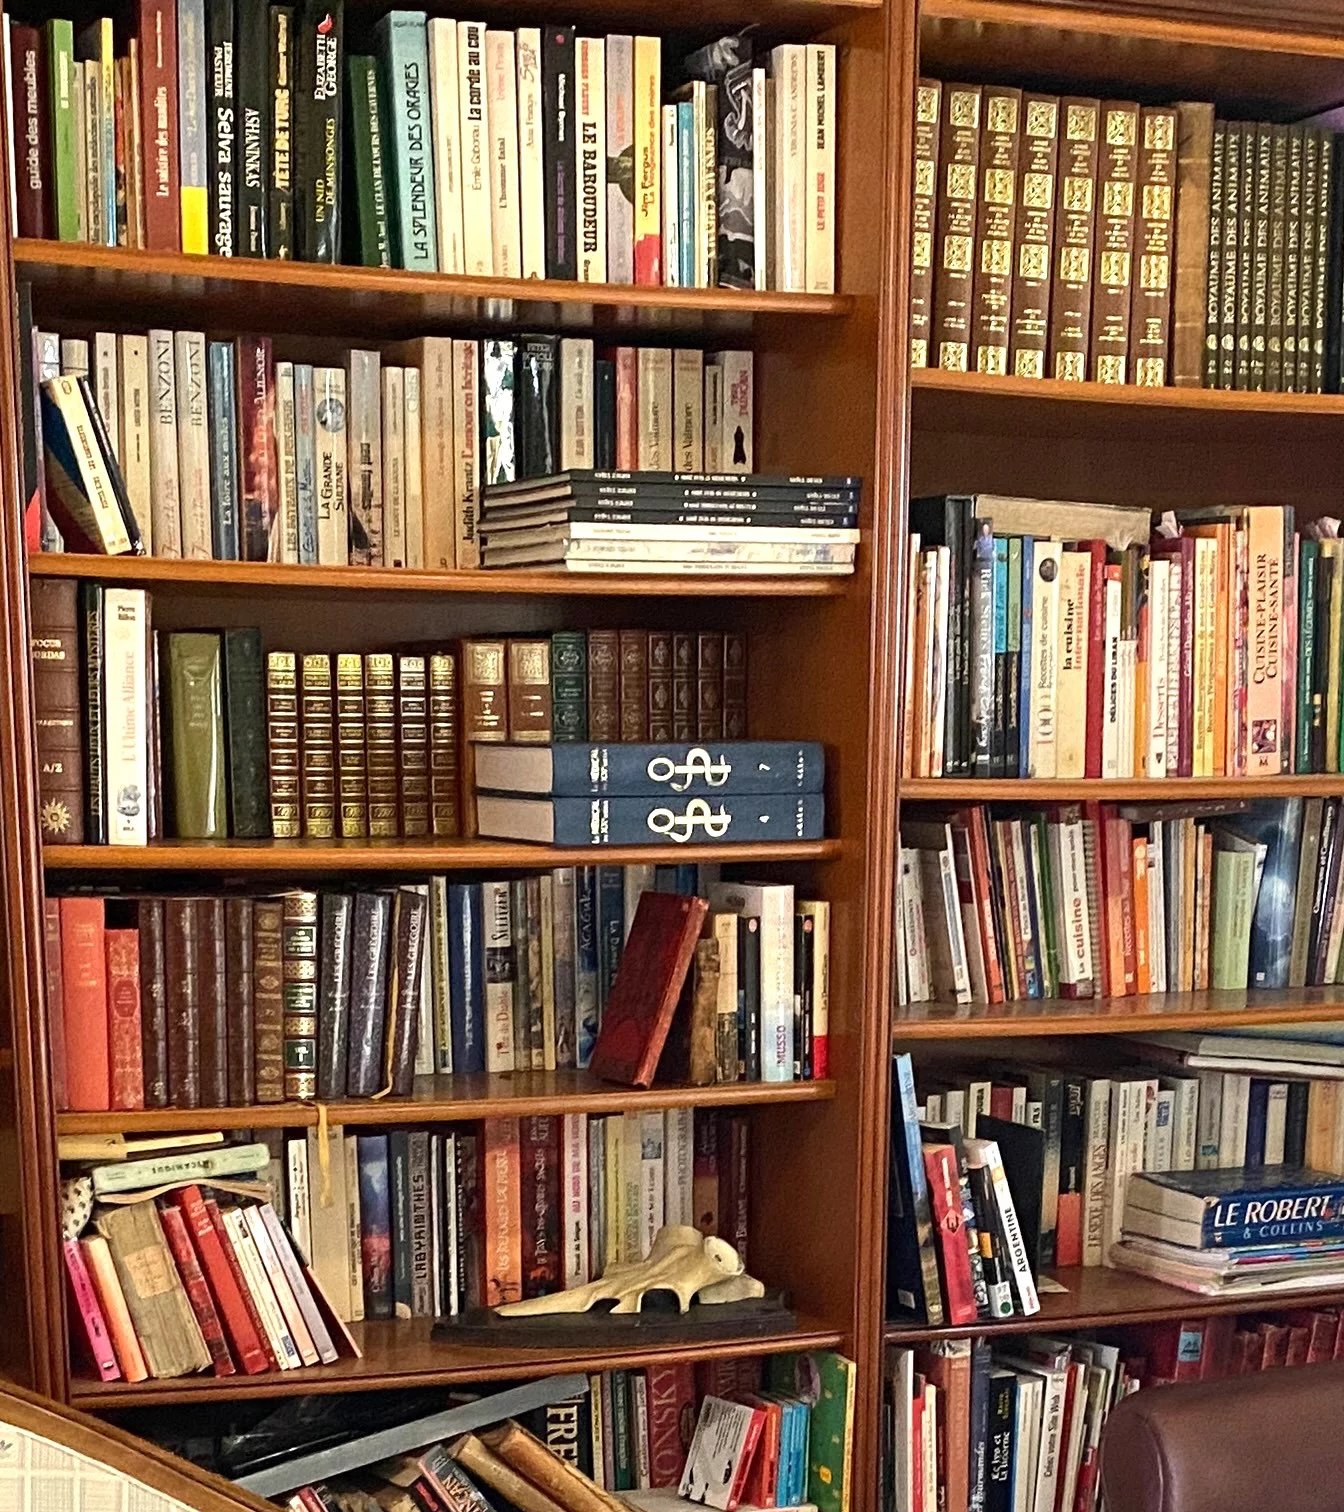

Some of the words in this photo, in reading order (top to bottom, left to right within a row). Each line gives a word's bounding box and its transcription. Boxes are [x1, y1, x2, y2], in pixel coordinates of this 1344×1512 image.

[467, 27, 480, 48] cou
[468, 51, 480, 66] au
[24, 50, 37, 114] meubles
[314, 34, 325, 100] ELIZABETH
[324, 37, 337, 96] GEORGE
[468, 70, 481, 105] corde
[274, 89, 289, 130] TURC
[403, 62, 421, 120] ORAGES
[468, 107, 482, 121] La
[25, 118, 38, 149] des
[217, 108, 234, 163] Selva
[245, 108, 260, 187] ASHANINKAS
[275, 131, 289, 151] DE
[325, 118, 335, 186] MENSONGES
[406, 124, 423, 151] DES
[497, 137, 506, 161] fatal
[582, 122, 597, 145] LE
[26, 151, 42, 189] guide
[271, 152, 290, 190] TÊTE
[498, 163, 508, 209] L'homme
[640, 146, 650, 190] Fergus
[1212, 133, 1225, 213] ANIMAUX
[1227, 133, 1240, 213] ANIMAUX
[1258, 136, 1270, 214] ANIMAUX
[1274, 136, 1287, 216] ANIMAUX
[214, 171, 233, 258] sauvage
[315, 180, 324, 203] NID
[316, 206, 325, 222] UN
[326, 187, 335, 205] DE
[408, 156, 427, 238] SPLENDEUR
[583, 149, 597, 252] BAROUDEUR
[641, 193, 650, 217] Jim
[412, 242, 429, 259] LA
[1211, 216, 1222, 245] DES
[1226, 217, 1237, 245] DES
[1257, 219, 1268, 247] DES
[1273, 220, 1285, 248] DES
[1209, 251, 1221, 324] ROYAUME
[1224, 251, 1237, 324] ROYAUME
[1254, 253, 1267, 325] ROYAUME
[1270, 254, 1283, 326] ROYAUME
[157, 338, 174, 426] BENZONI
[188, 340, 204, 427] BENZONI
[461, 342, 477, 391] héritage
[462, 392, 474, 407] en
[738, 370, 749, 417] DUNCAN
[461, 408, 475, 459] L'amour
[320, 452, 333, 499] GRANDE
[332, 462, 344, 512] SULTANE
[461, 461, 474, 504] Krantz
[318, 501, 332, 520] LA
[462, 506, 474, 544] Judith
[1064, 598, 1074, 654] cuisine
[1074, 564, 1085, 670] internationale
[1254, 553, 1267, 685] CUISINE-PLAISIR
[1266, 558, 1279, 679] CUISINE-SANTÉ
[120, 651, 135, 703] Alliance
[1064, 657, 1073, 670] la
[1111, 667, 1118, 680] DU
[1110, 682, 1118, 723] DÉLICES
[1154, 677, 1165, 739] Desserts
[121, 707, 136, 762] L'Ultime
[43, 763, 62, 773] A/Z
[776, 1025, 785, 1066] MUSSO
[412, 1174, 426, 1279] LABYRINTHES
[1214, 1203, 1241, 1228] LE
[1244, 1195, 1332, 1224] ROBERT
[1243, 1226, 1252, 1240] &
[1259, 1221, 1324, 1238] COLLINS
[1002, 1206, 1028, 1273] ARGENTINE
